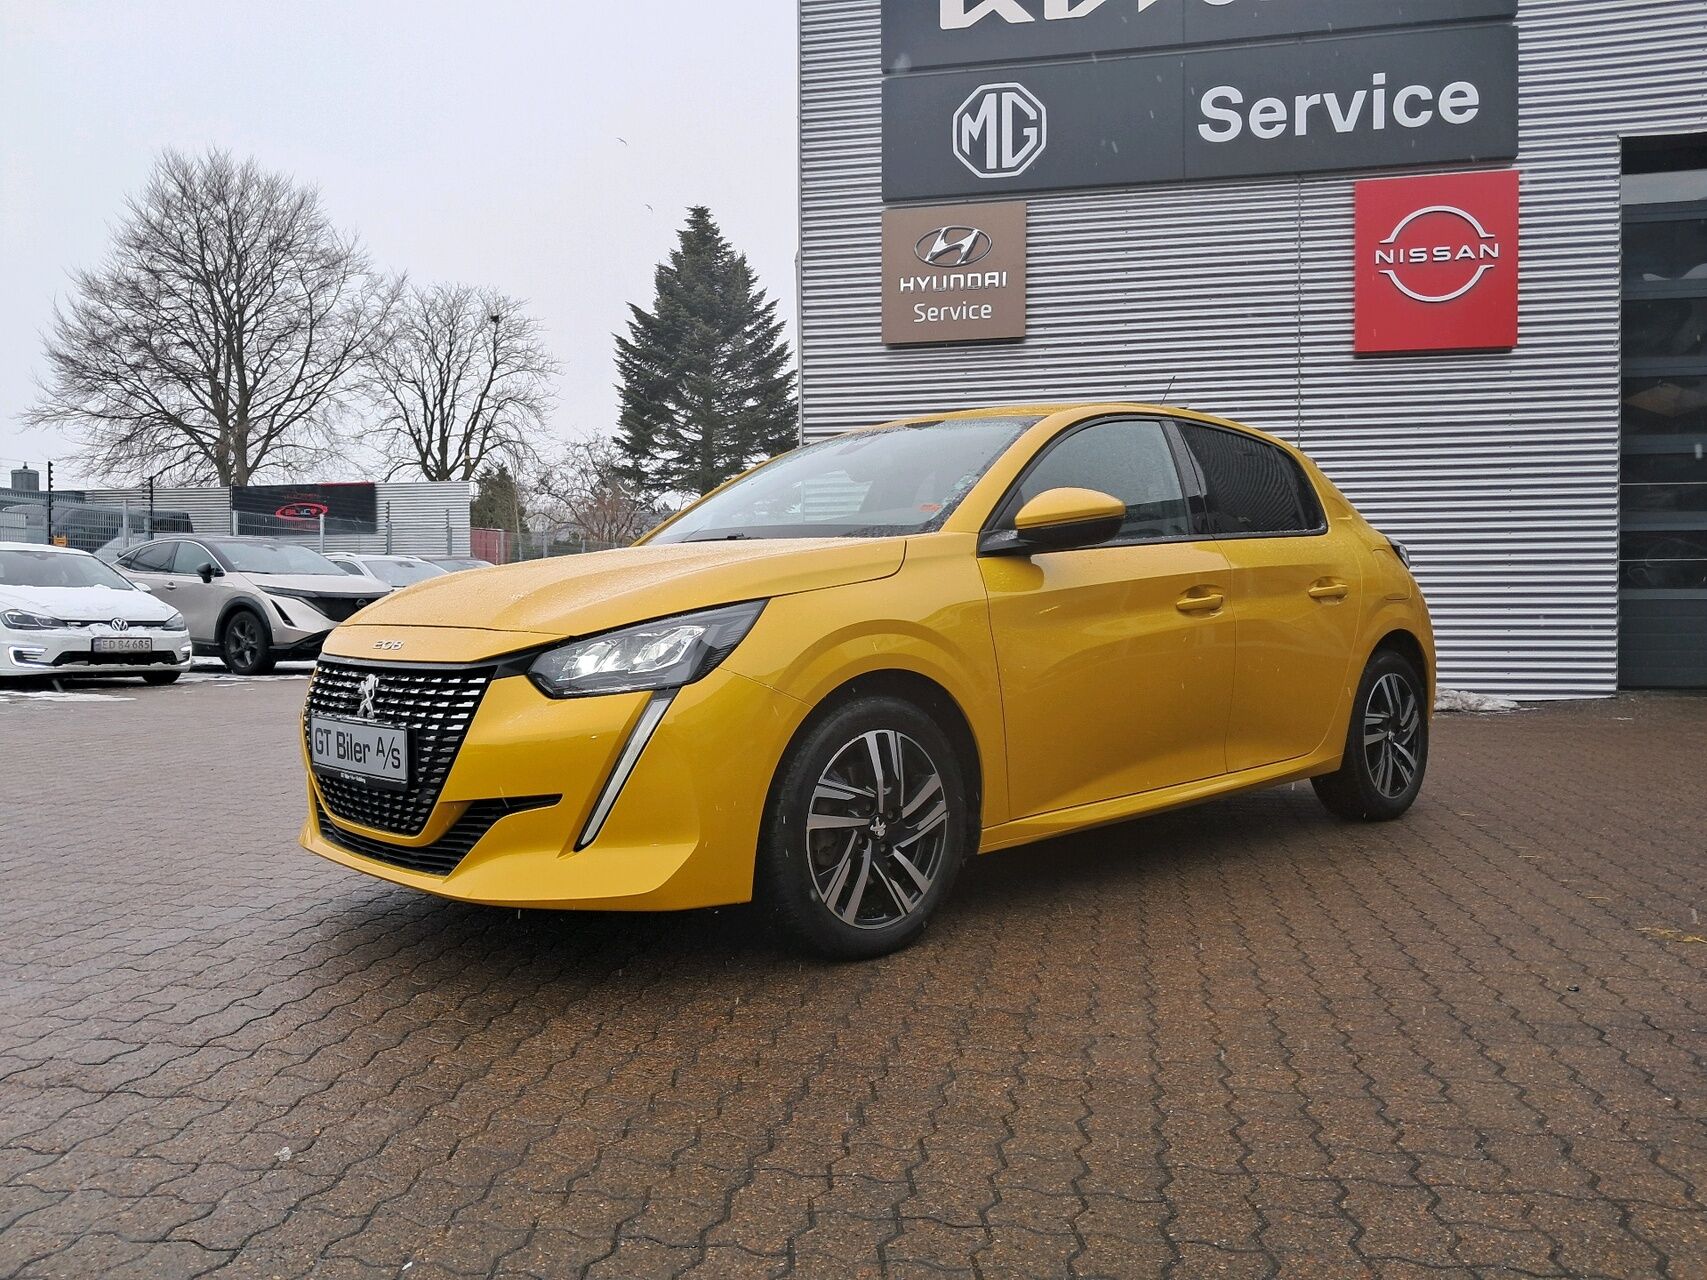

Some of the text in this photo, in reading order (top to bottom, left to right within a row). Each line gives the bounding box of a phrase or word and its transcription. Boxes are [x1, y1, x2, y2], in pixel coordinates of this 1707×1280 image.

[961, 72, 1480, 170] MG Service
[1375, 243, 1499, 265] NISSAN
[899, 271, 1008, 293] HYUNDAI
[913, 300, 993, 323] Service
[314, 727, 332, 757] GT
[336, 731, 371, 764] Biler
